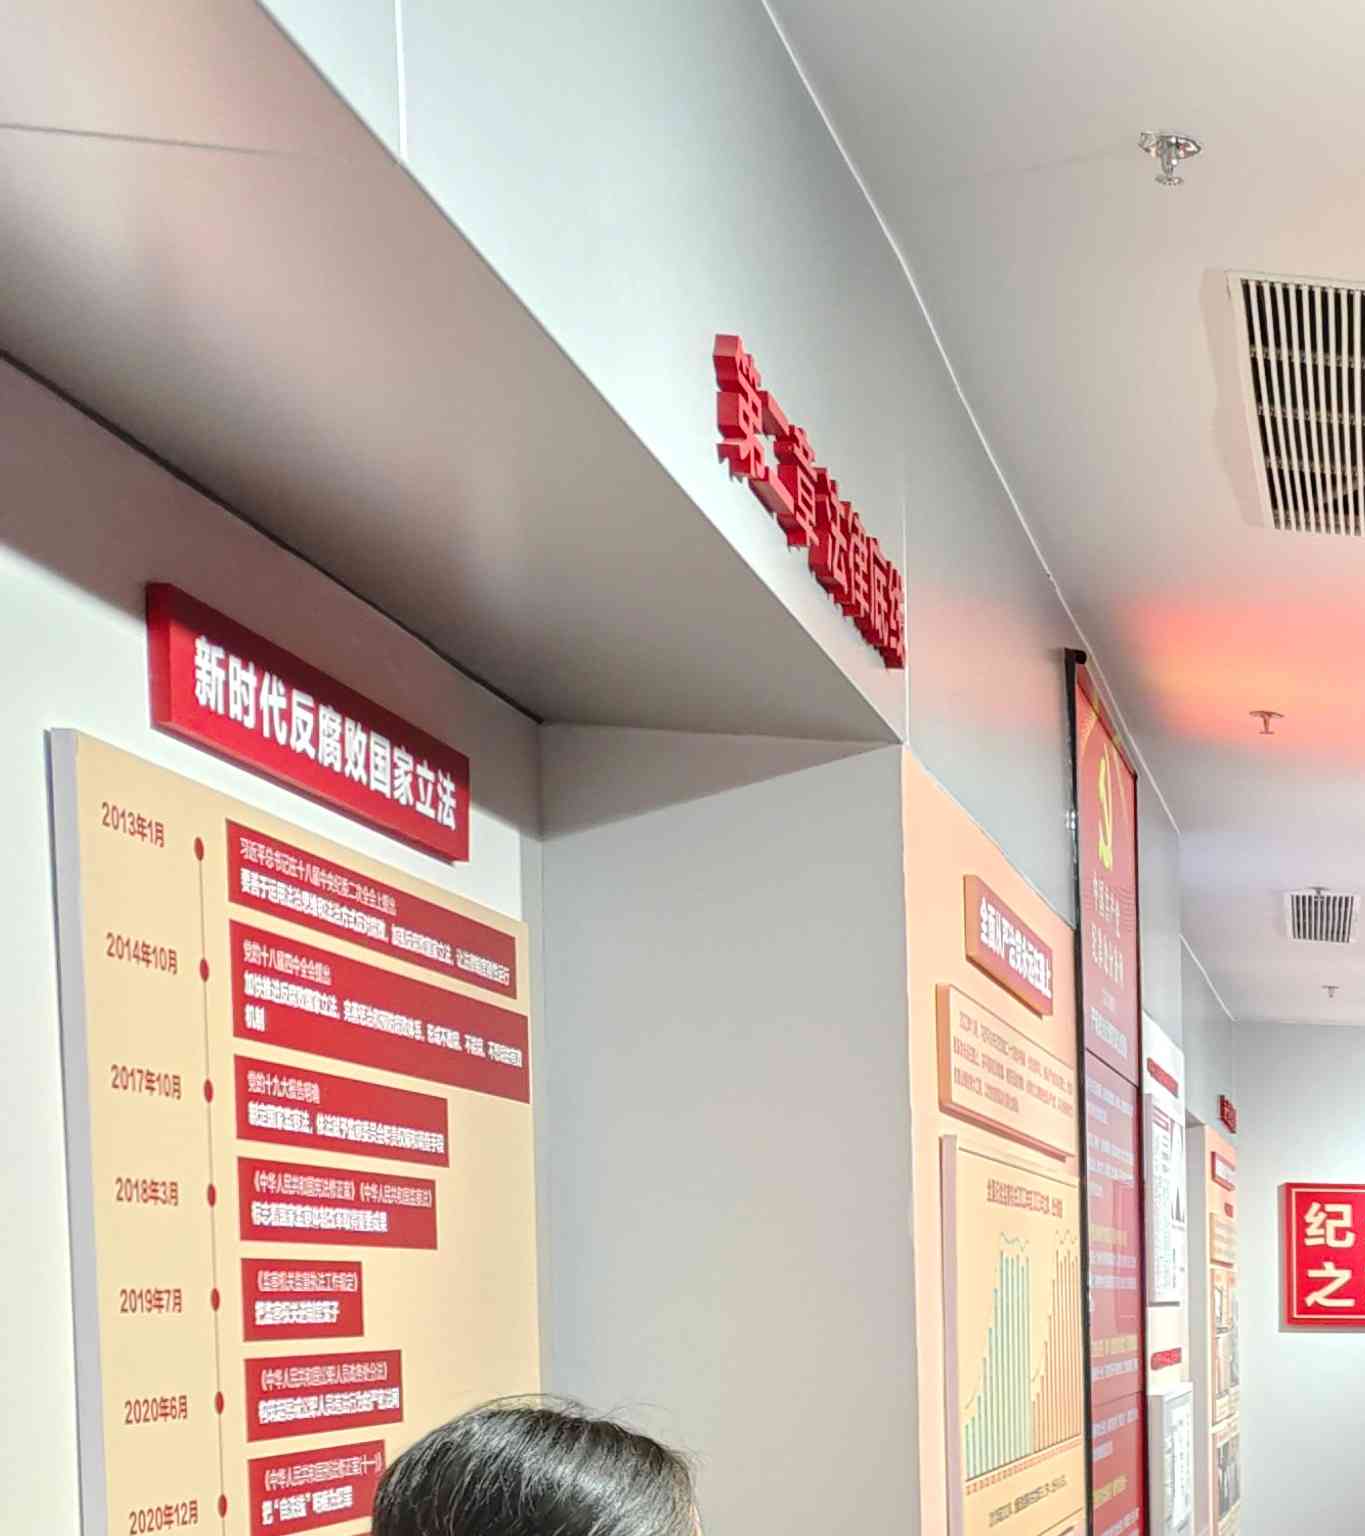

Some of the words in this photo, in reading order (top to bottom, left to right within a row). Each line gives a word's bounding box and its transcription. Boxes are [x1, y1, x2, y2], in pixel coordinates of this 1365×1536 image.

[194, 637, 456, 831] 新时代反腐败国家立法
[102, 802, 165, 848] 2013年1月
[106, 934, 178, 975] 2014年10月
[111, 1066, 182, 1100] 2017年10月
[116, 1177, 178, 1206] 2018年3月
[119, 1287, 182, 1315] 2019年7月
[125, 1394, 188, 1426] 2020年6月
[129, 1499, 199, 1536] 2020年12月
